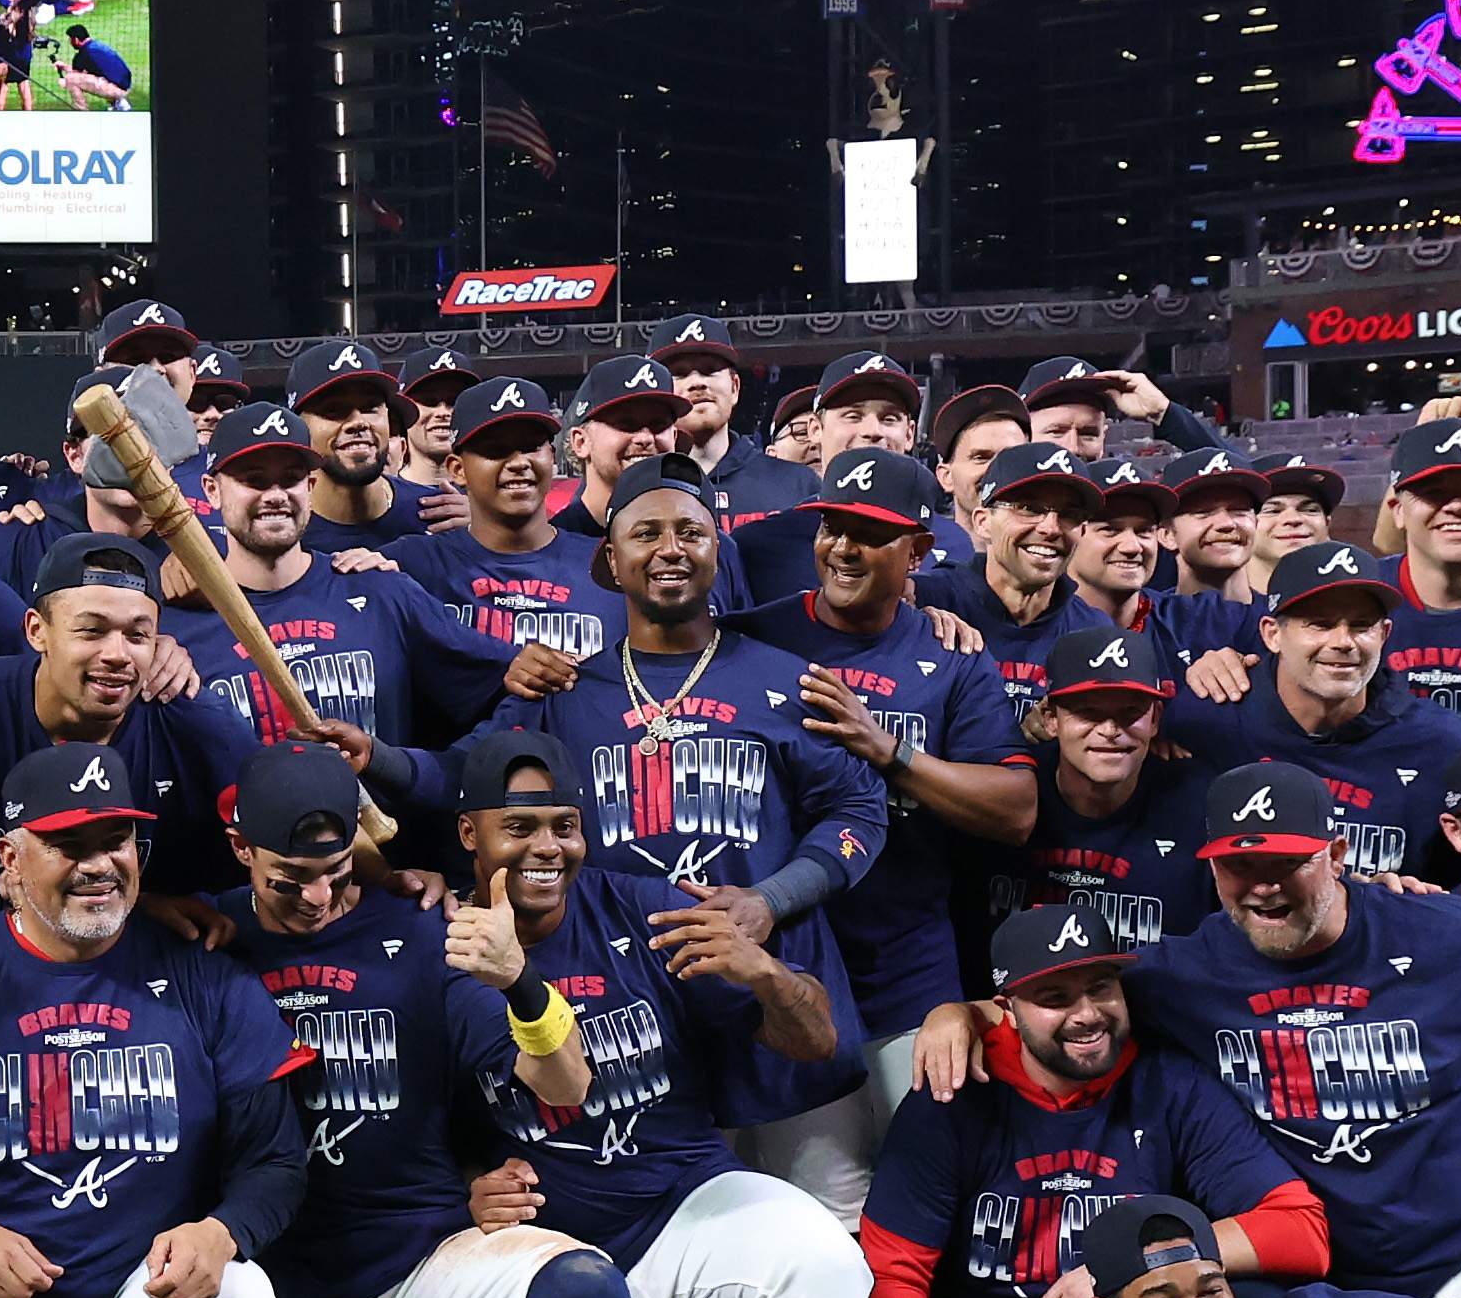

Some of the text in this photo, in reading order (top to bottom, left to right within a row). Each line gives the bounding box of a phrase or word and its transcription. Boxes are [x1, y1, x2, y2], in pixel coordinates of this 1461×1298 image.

[44, 189, 93, 202] Heating
[66, 203, 127, 215] Electrical
[453, 275, 595, 306] RaceTrac
[1307, 304, 1414, 347] Coors
[470, 577, 571, 603] BRAVES
[591, 738, 769, 848] CLINCHED
[1247, 983, 1371, 1015] BRAVES
[16, 1002, 132, 1038] BRAVES
[1277, 1007, 1345, 1025] POSTSEASON
[44, 1028, 107, 1049] POSTSEASON
[294, 1006, 400, 1113] CHED
[1216, 1018, 1431, 1122] CLINCHED
[1015, 1148, 1120, 1181] BRAVES
[1041, 1171, 1093, 1192] POSTSEASON
